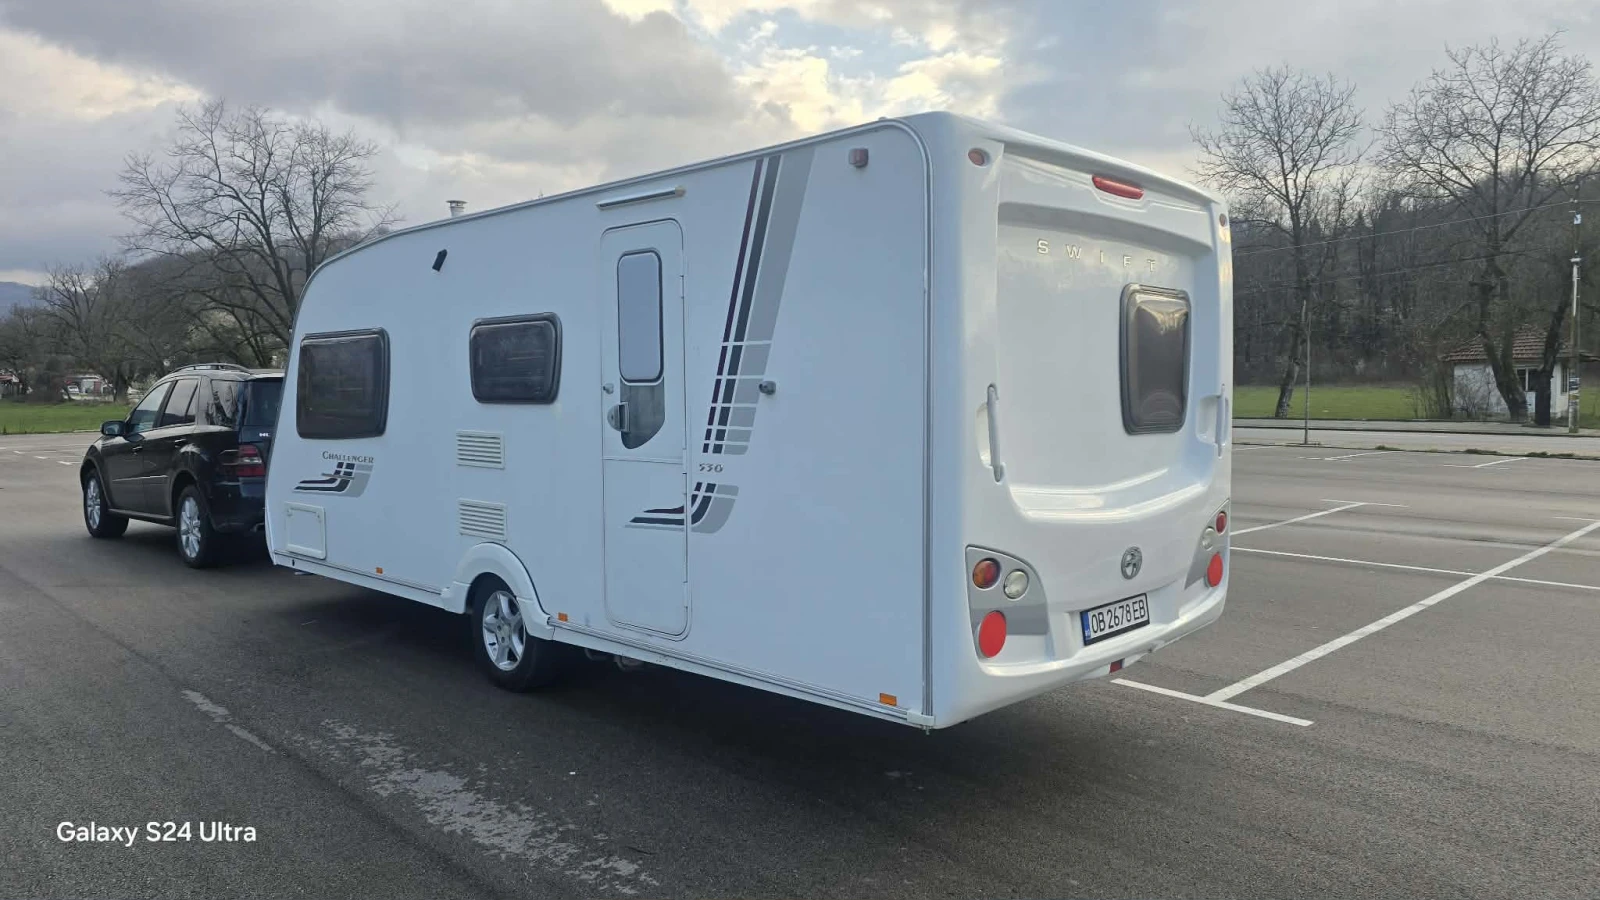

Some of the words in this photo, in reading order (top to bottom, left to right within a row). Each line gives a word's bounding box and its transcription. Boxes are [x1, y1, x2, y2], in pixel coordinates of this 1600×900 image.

[1037, 238, 1156, 272] SWIFT
[1091, 612, 1106, 633] OB
[1107, 603, 1131, 629] 2678
[1132, 599, 1146, 620] EB
